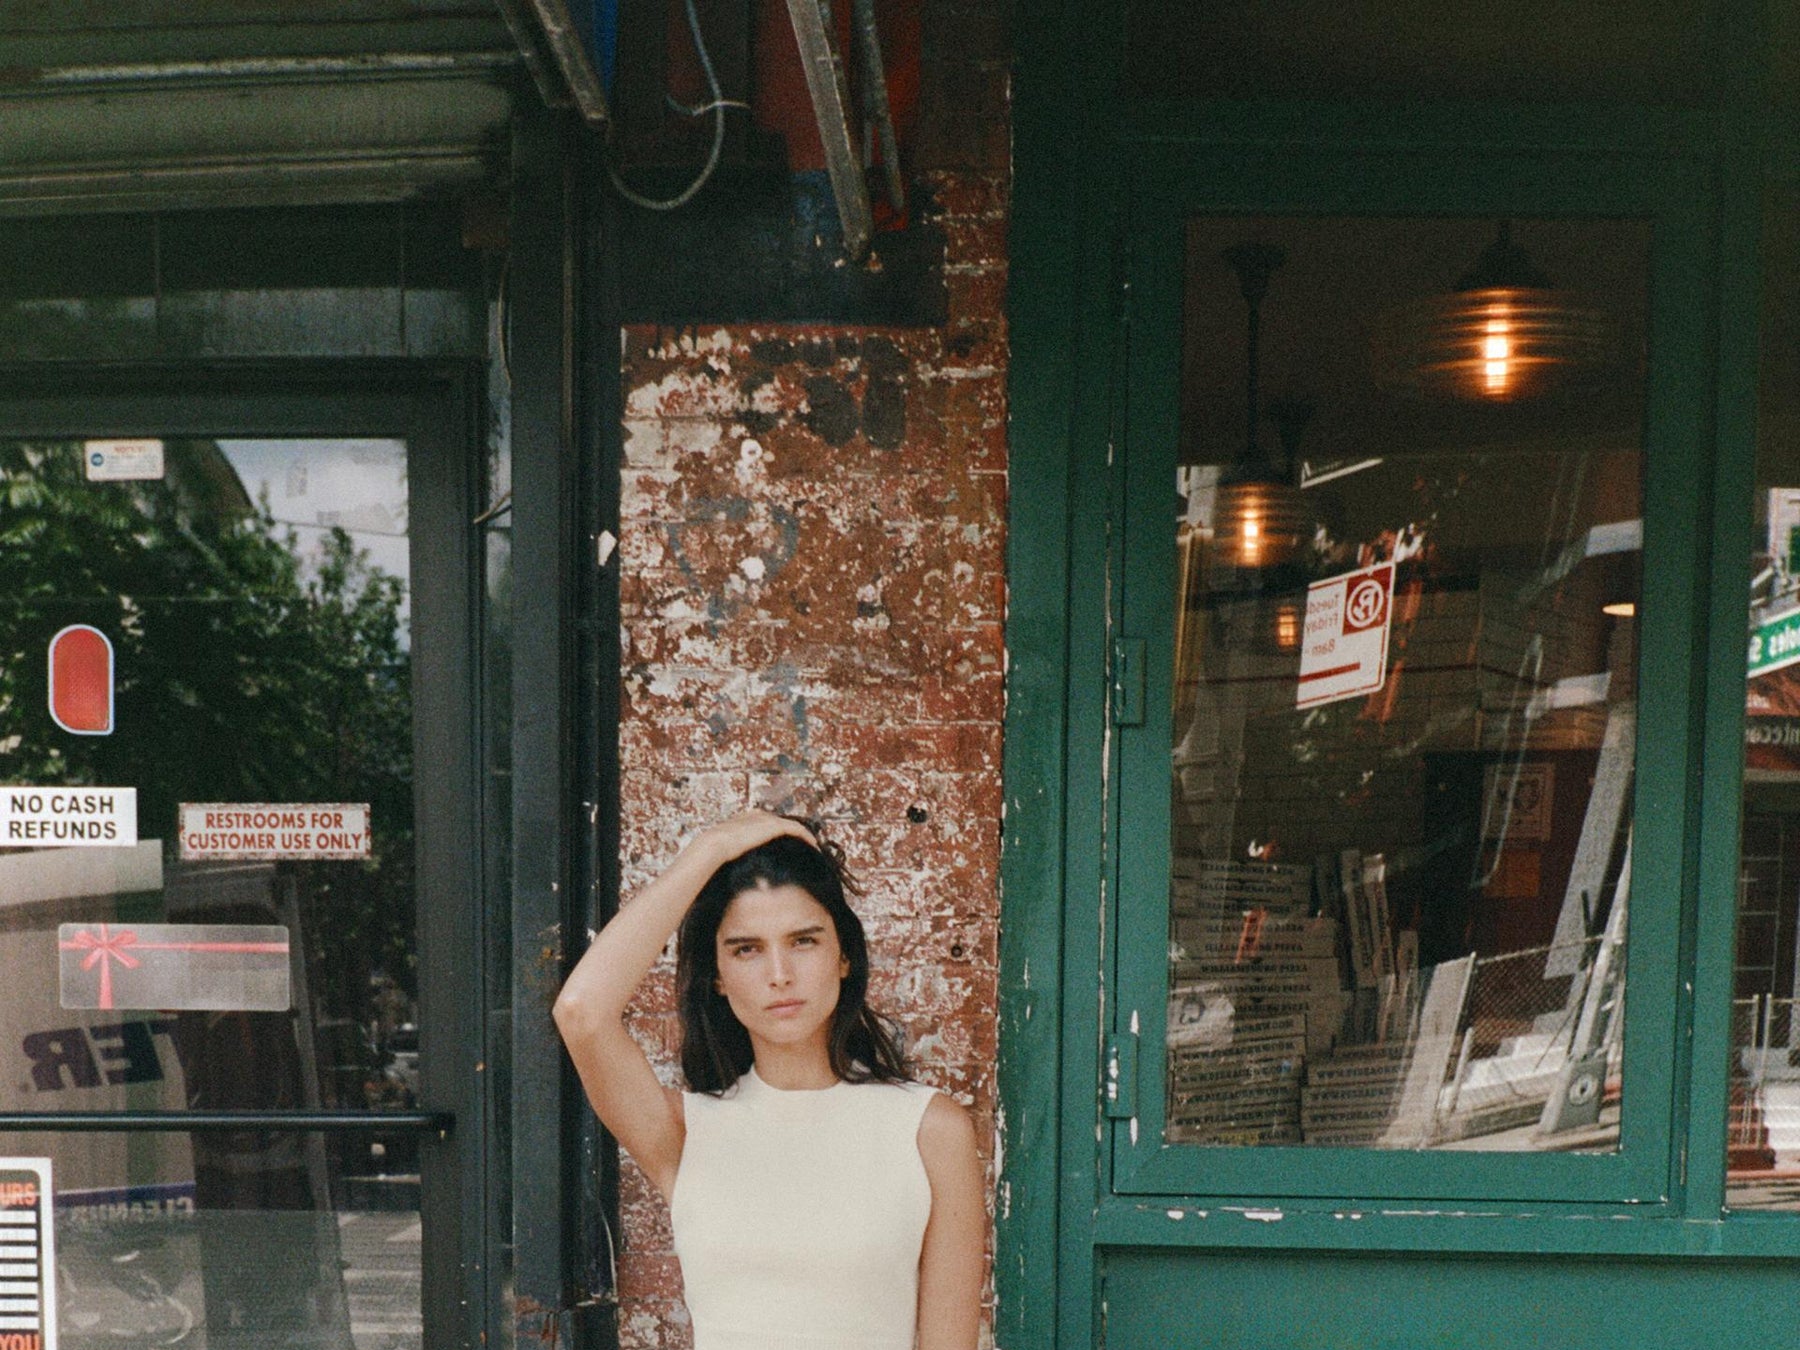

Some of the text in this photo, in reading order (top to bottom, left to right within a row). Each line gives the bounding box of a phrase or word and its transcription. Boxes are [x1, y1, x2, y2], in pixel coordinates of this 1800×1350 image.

[11, 795, 115, 814] NO CASH
[9, 820, 117, 839] REFUNDS
[206, 813, 343, 829] RESTROOMS FOR
[187, 833, 362, 850] CUSTOMER USE ONLY
